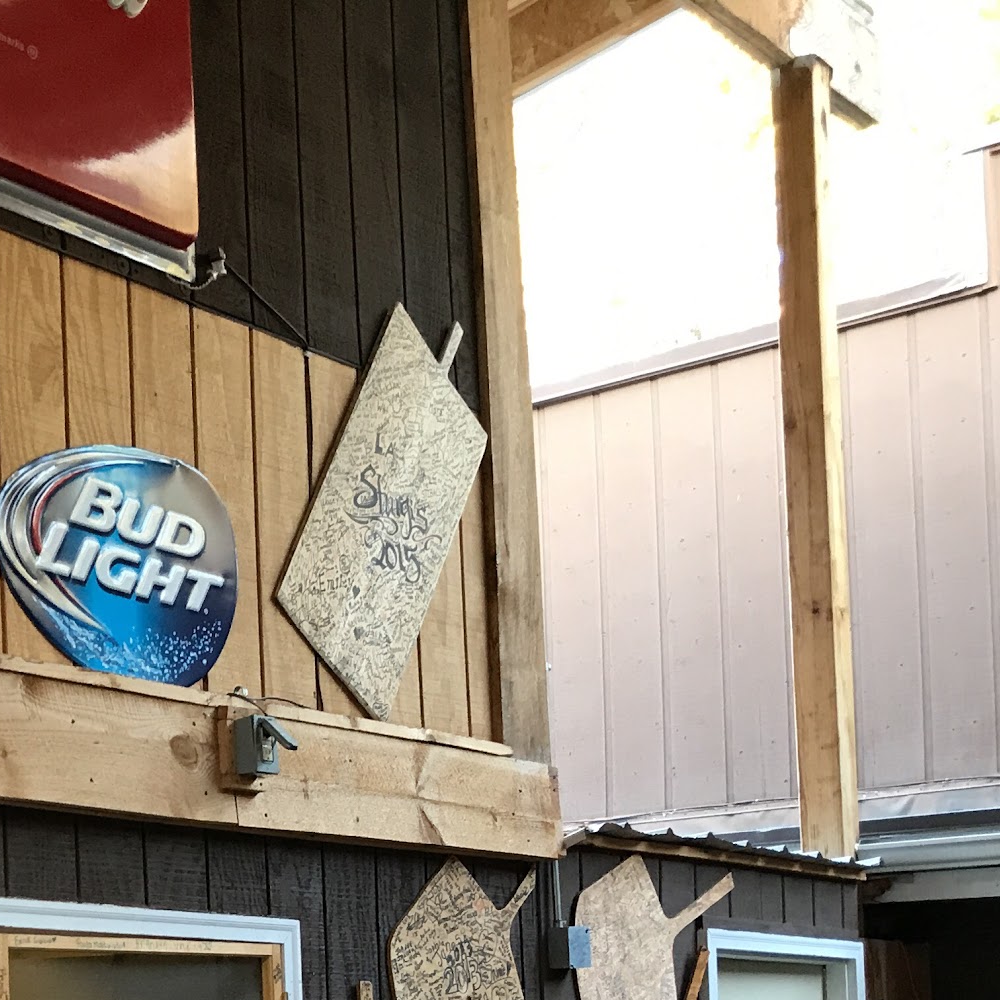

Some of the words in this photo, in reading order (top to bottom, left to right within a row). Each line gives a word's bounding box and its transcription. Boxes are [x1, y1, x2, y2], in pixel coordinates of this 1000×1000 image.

[70, 476, 206, 558] BUD
[35, 520, 225, 613] LIGHT
[370, 534, 421, 584] 2015
